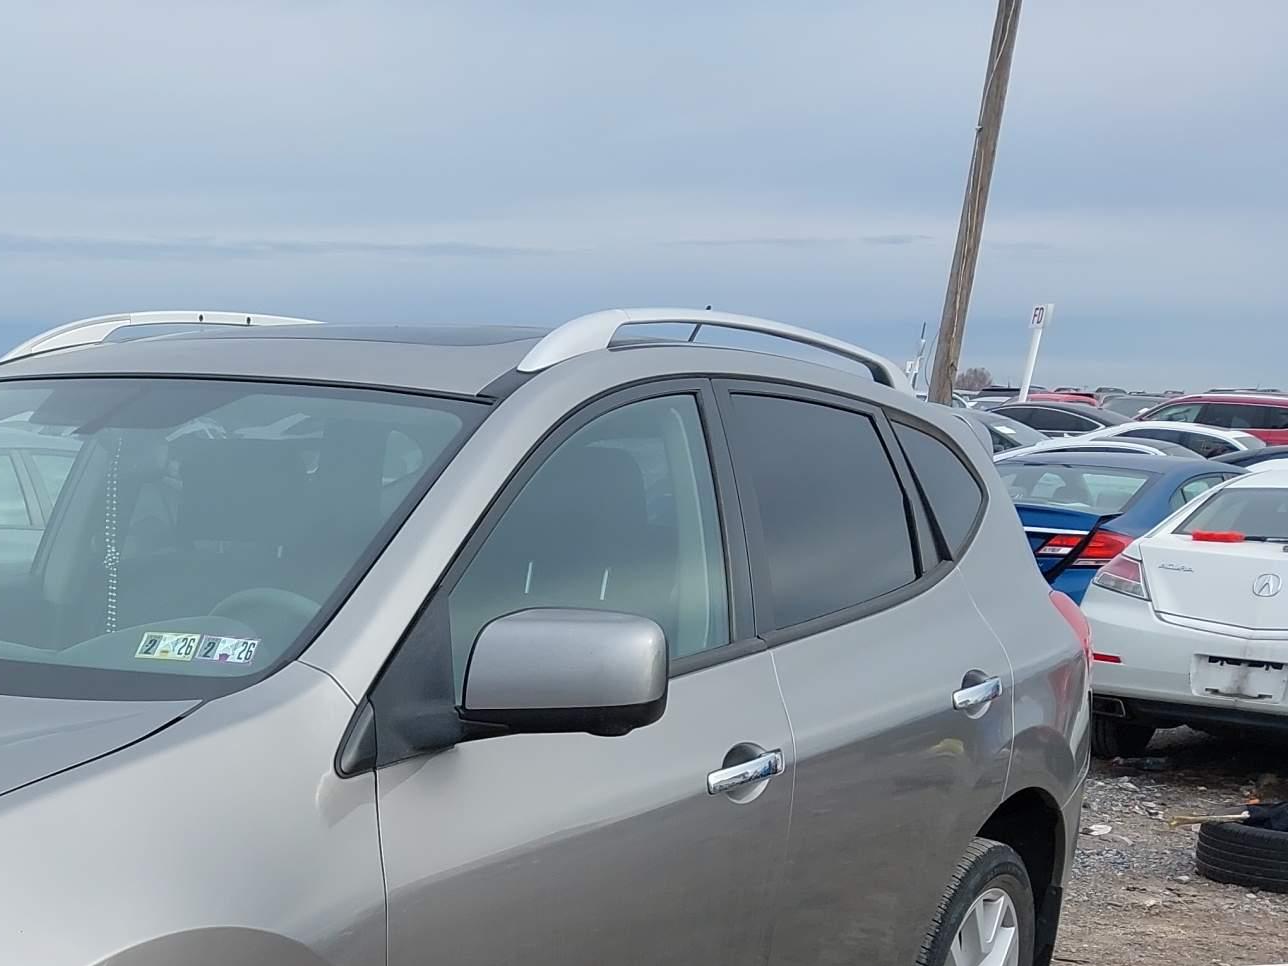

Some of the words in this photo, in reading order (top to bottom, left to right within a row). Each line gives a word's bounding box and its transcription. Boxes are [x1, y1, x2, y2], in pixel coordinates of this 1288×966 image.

[1032, 306, 1045, 325] FD
[177, 637, 196, 656] 26
[202, 641, 216, 658] 2
[237, 641, 256, 661] 26
